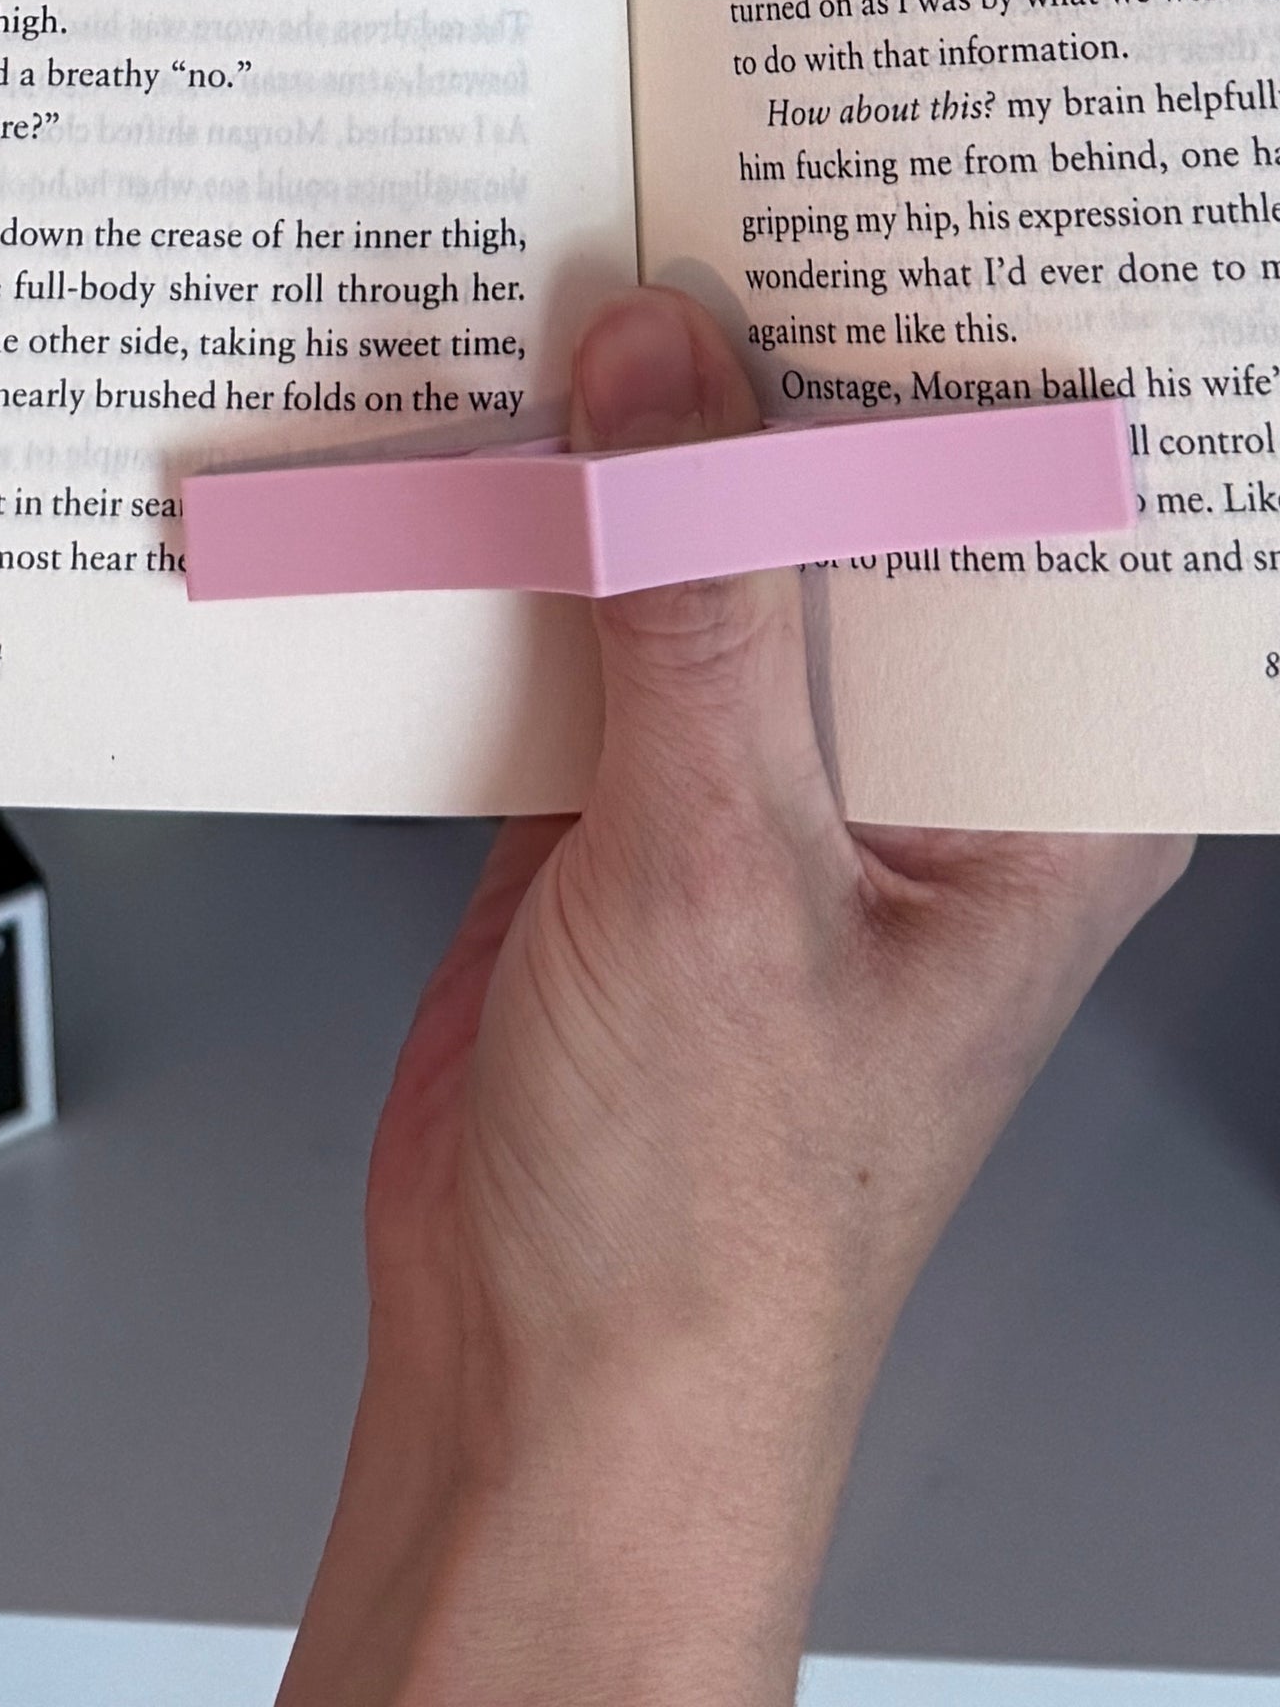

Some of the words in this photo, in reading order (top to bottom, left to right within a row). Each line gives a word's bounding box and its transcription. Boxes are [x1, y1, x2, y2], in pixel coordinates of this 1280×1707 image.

[27, 323, 112, 356] other
[119, 323, 190, 362] side,
[198, 324, 297, 366] taking
[304, 325, 350, 358] his
[357, 334, 443, 359] sweet
[450, 326, 526, 362] time,
[746, 314, 838, 353] against
[844, 323, 887, 346] me
[893, 311, 947, 345] like
[953, 310, 1018, 345] this.
[1128, 422, 1150, 457] ll
[1158, 419, 1277, 457] control
[13, 486, 43, 517] in
[51, 484, 124, 518] their
[129, 495, 183, 519] sea
[1155, 491, 1214, 516] me.
[69, 539, 139, 573] hear
